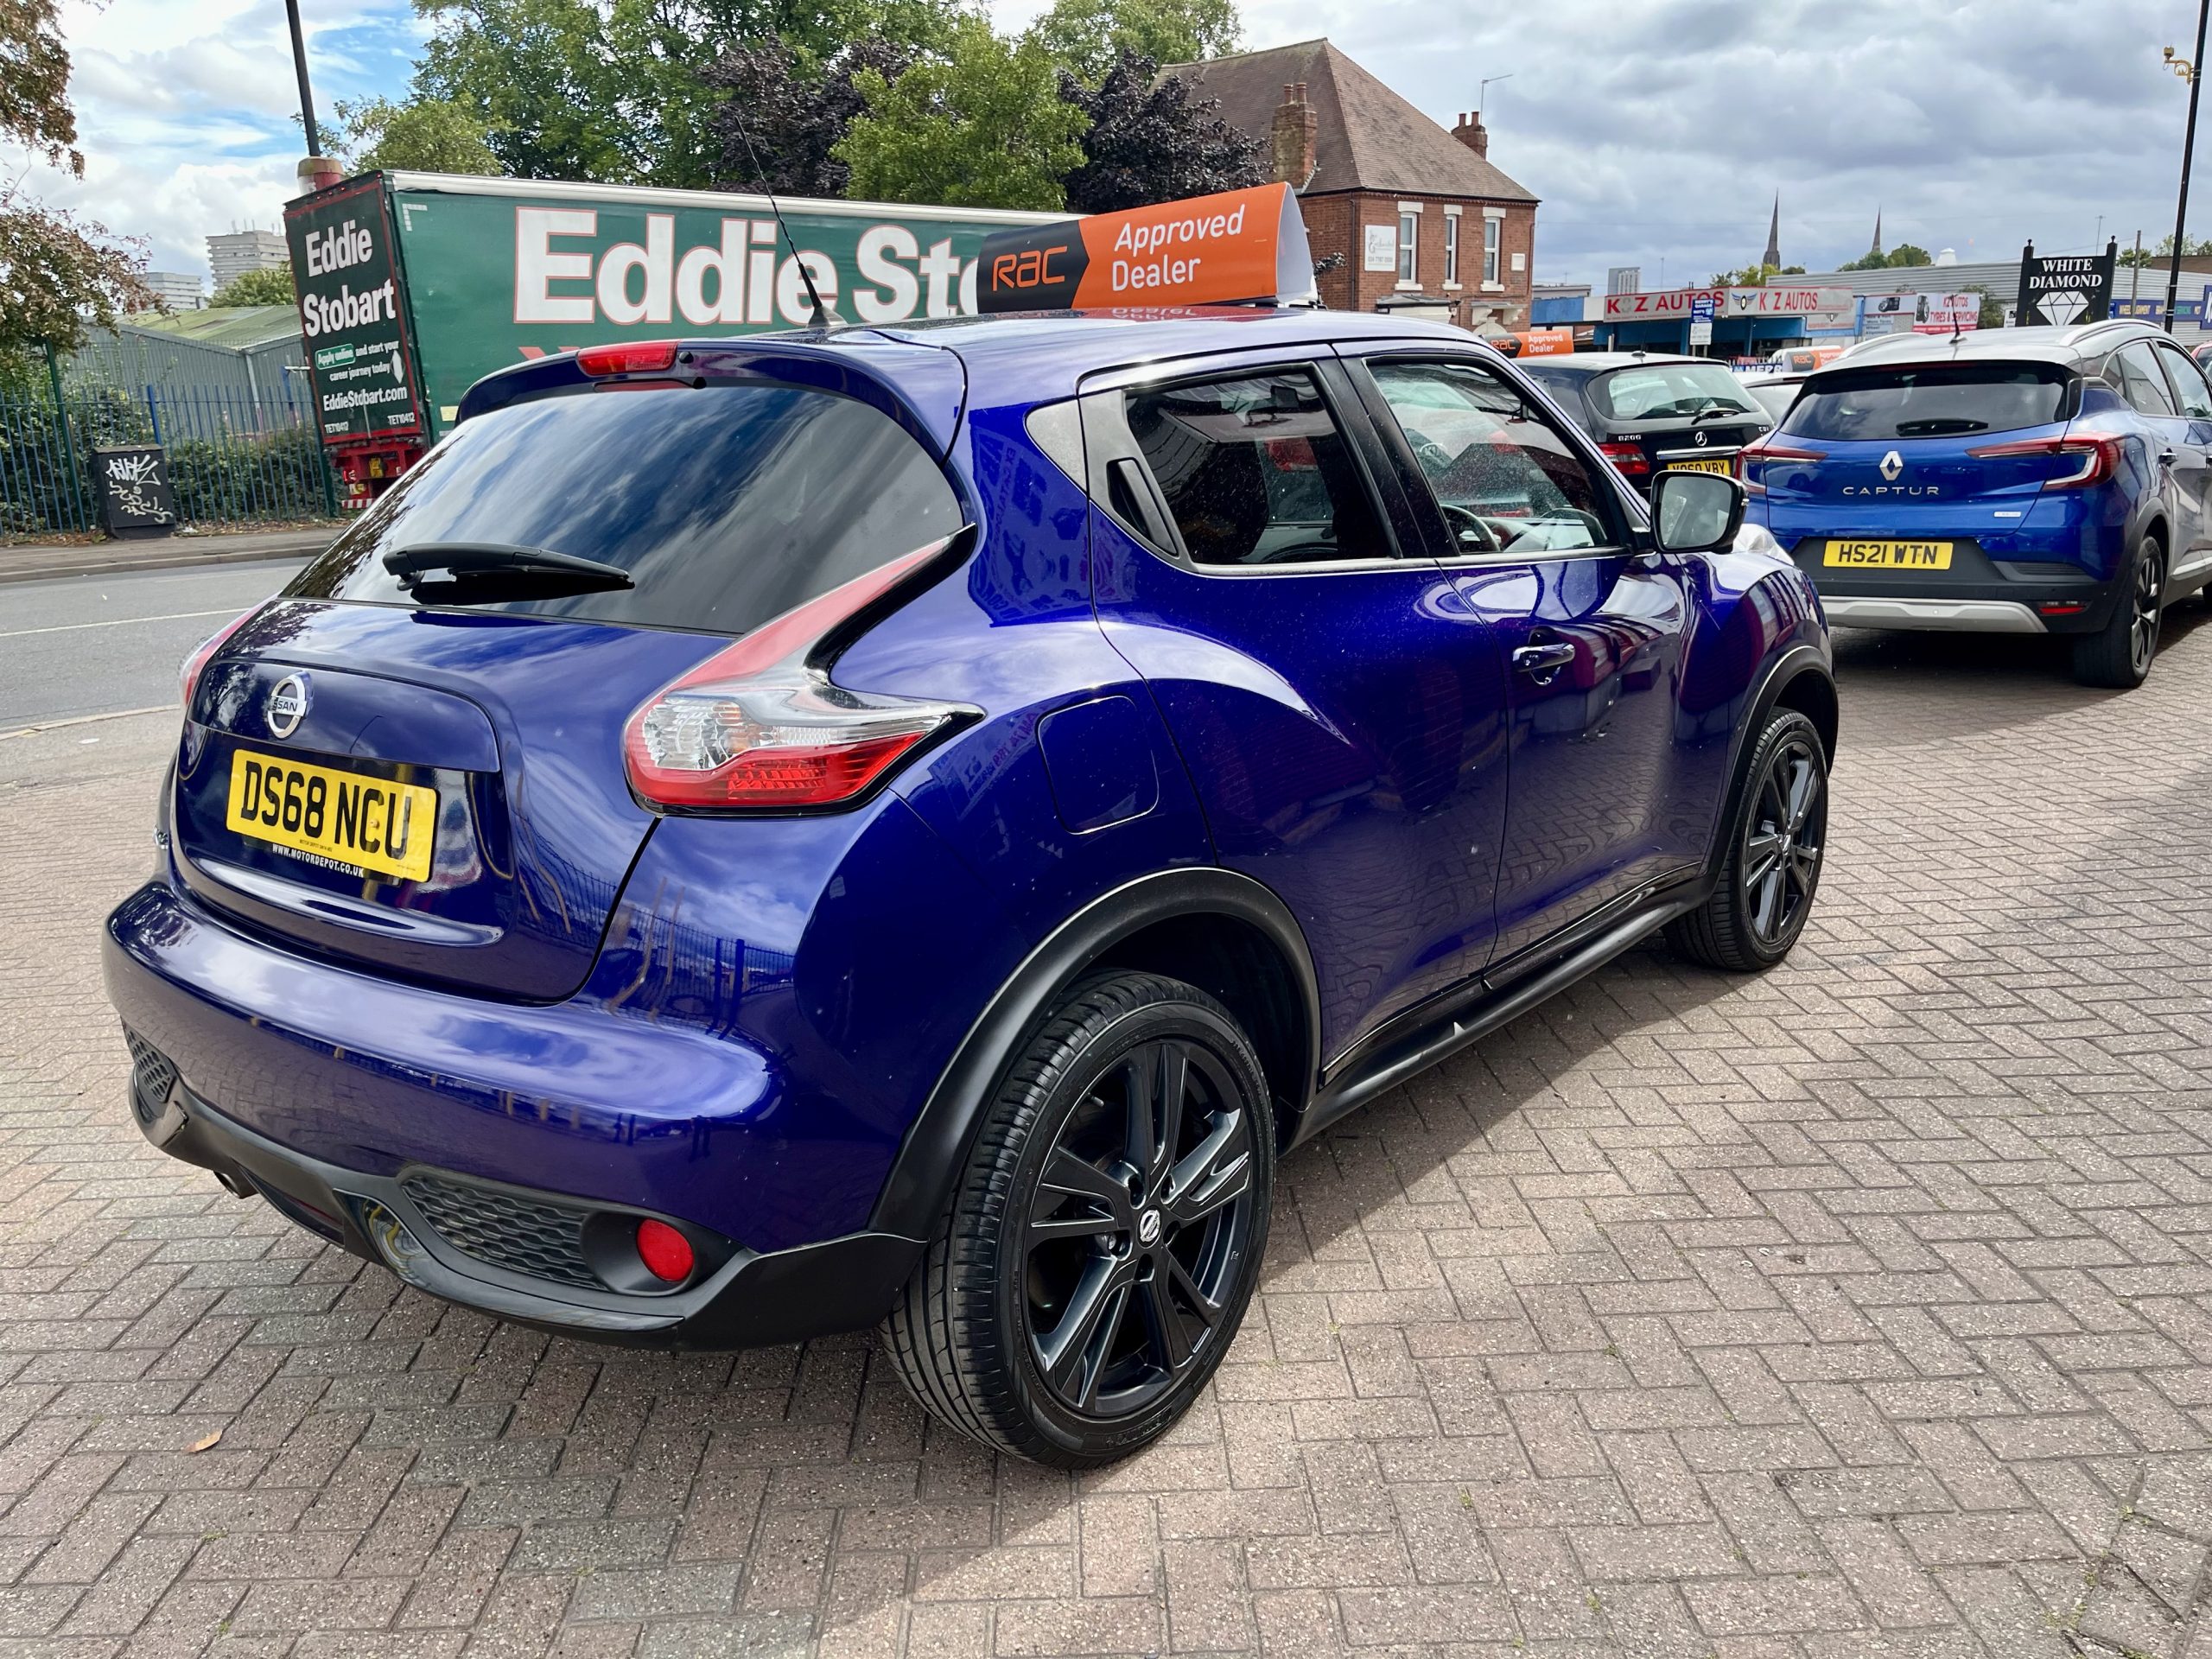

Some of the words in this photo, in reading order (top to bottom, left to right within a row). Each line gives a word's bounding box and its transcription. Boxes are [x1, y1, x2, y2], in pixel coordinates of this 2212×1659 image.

[1114, 204, 1246, 257] Approved
[305, 219, 373, 276] Eddie
[513, 206, 838, 326] Eddie
[1112, 258, 1202, 292] Dealer
[2042, 258, 2093, 273] WHITE
[2028, 274, 2103, 289] DIAMOND
[302, 278, 397, 337] Stobart
[1607, 298, 1621, 314] K
[1759, 292, 1768, 311] K
[1773, 292, 1783, 310] Z
[1783, 292, 1818, 311] AUTOS
[1929, 311, 1946, 322] TYRES
[355, 344, 368, 357] and
[368, 342, 384, 354] start
[1528, 334, 1563, 345] Approved
[1529, 344, 1554, 353] Dealer
[329, 370, 348, 381] career
[348, 366, 372, 380] journey
[372, 361, 391, 374] today
[322, 386, 408, 411] EddieStobart.com
[1842, 486, 1940, 495] CAPTUR
[1838, 543, 1888, 563] HS21
[1893, 544, 1938, 565] WTN
[240, 760, 327, 839] DS68
[334, 781, 412, 861] NCU
[272, 842, 365, 878] WWW.MOTORDEPOT.CO.UK
